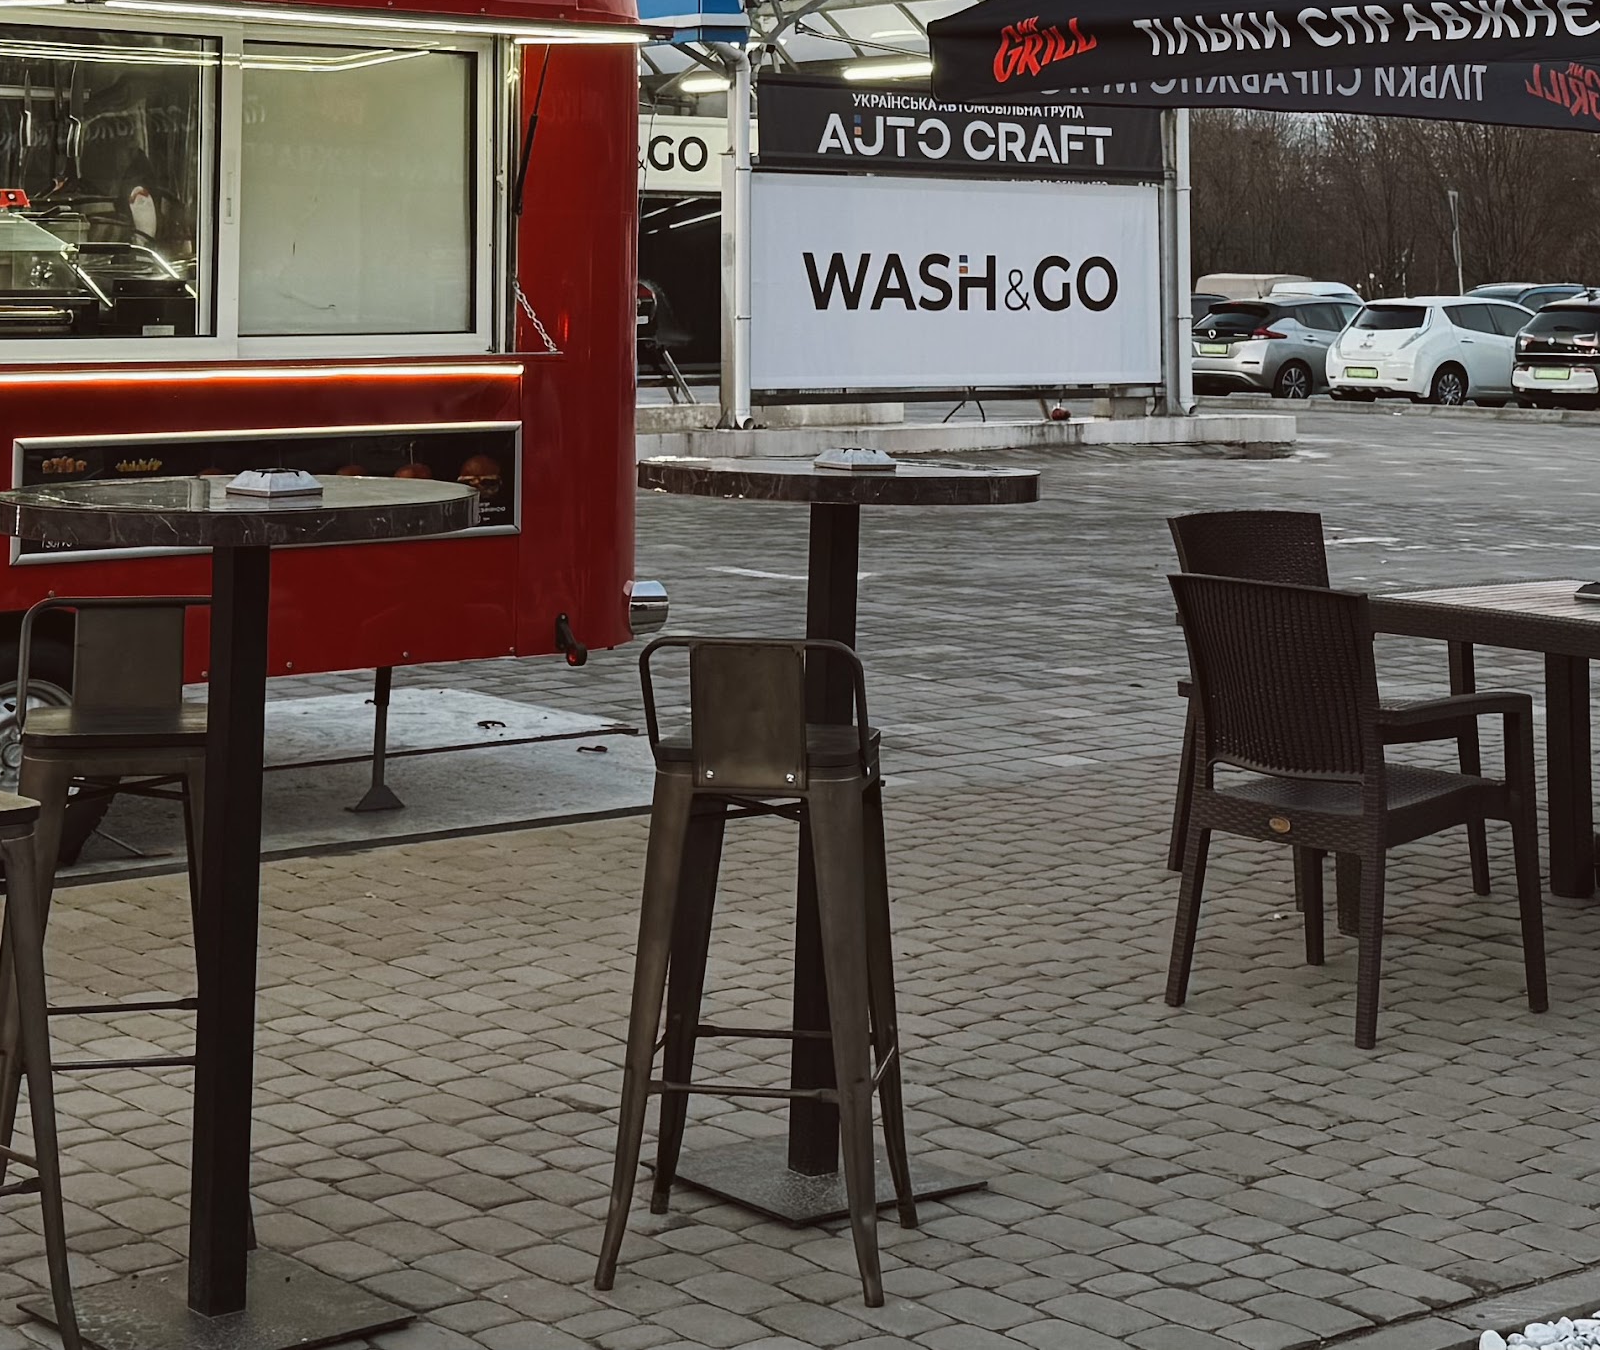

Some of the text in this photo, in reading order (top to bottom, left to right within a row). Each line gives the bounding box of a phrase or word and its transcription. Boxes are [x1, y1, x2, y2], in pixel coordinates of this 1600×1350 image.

[992, 17, 1098, 83] GRILL
[1132, 10, 1291, 56] ТІЛЬКИ
[851, 91, 938, 112] УКРАЇНСЬКА
[817, 112, 1113, 166] AUTO CRAFT
[801, 251, 1119, 313] WASH&GO
